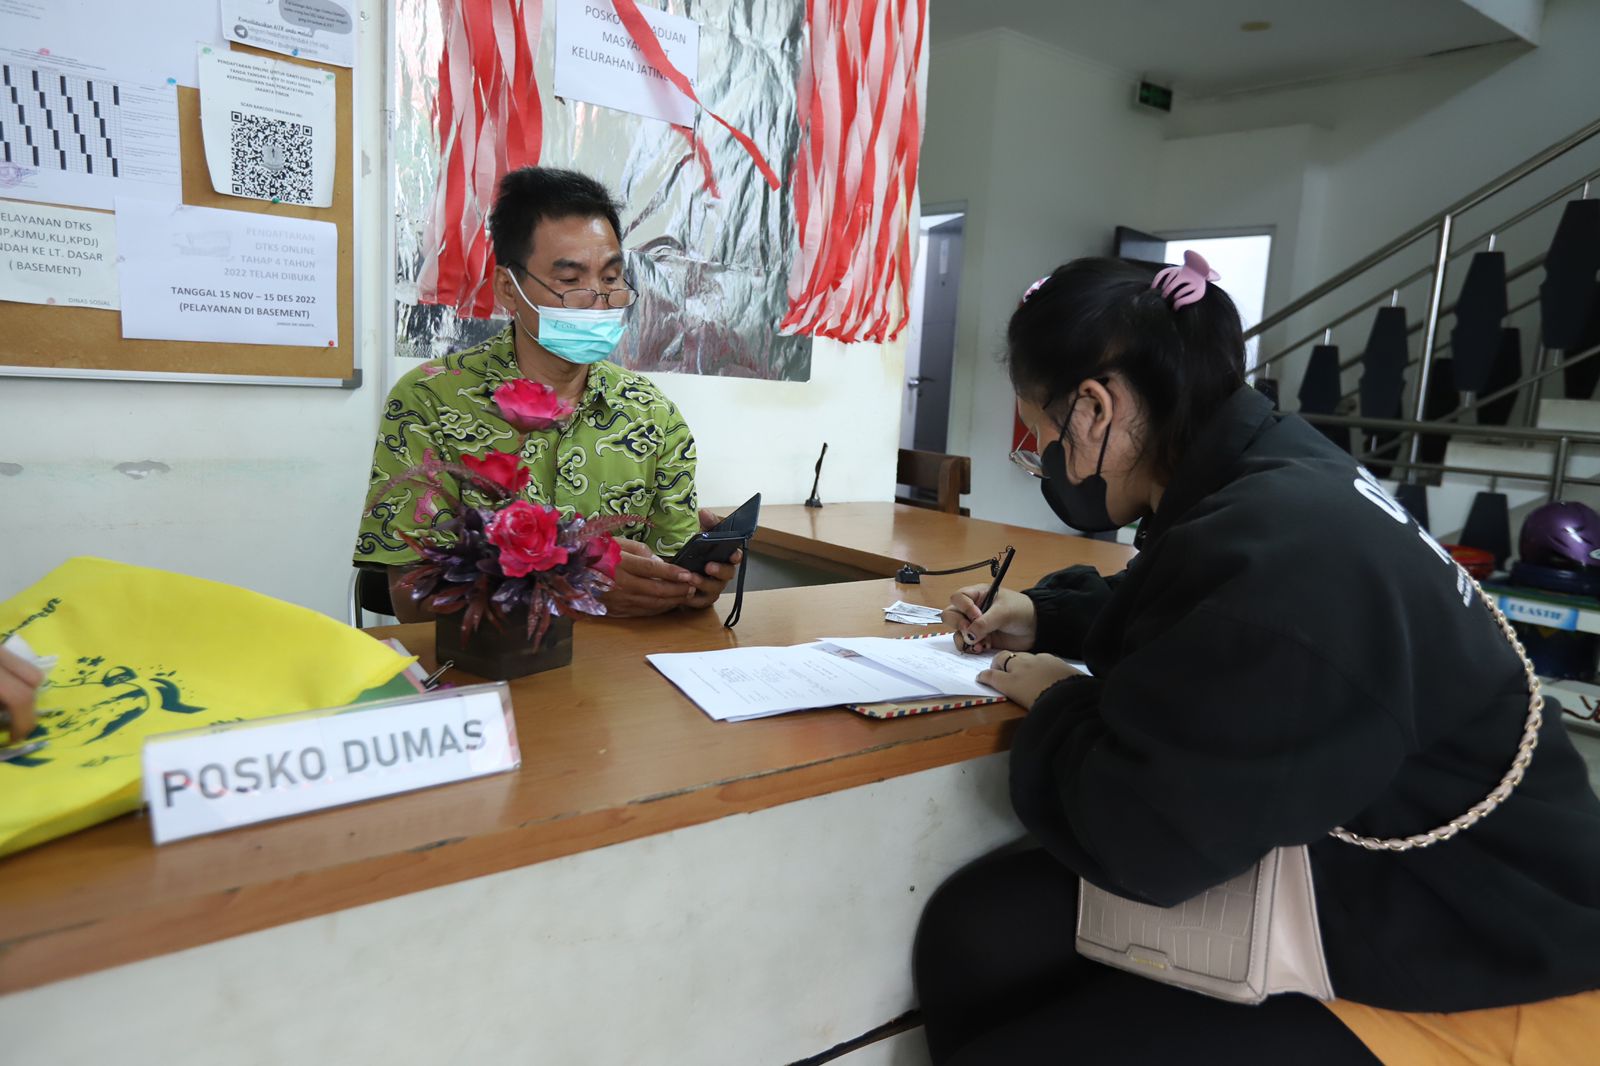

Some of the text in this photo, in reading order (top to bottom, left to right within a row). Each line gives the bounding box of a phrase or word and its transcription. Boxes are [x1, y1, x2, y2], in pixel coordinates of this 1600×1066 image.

[585, 5, 621, 25] POSKO
[571, 45, 634, 71] KELURAHAN
[0, 212, 92, 231] ELAYANAN DTKS
[32, 246, 45, 256] KE
[67, 250, 103, 261] DASAR
[255, 242, 316, 255] DTKS ONLINE
[241, 255, 272, 265] TAHAP
[284, 258, 316, 269] TAHUN
[224, 267, 316, 282] 2022 TELAH DIBUKA
[171, 286, 217, 298] TANGGAL
[220, 290, 231, 298] 15
[233, 291, 254, 300] NOV
[264, 293, 275, 301] 15
[277, 294, 293, 303] DES
[295, 295, 316, 304] 2022
[179, 302, 310, 320] (PELAYANAN DI BASEMENT)
[163, 719, 484, 808] POSKO DUMAS
